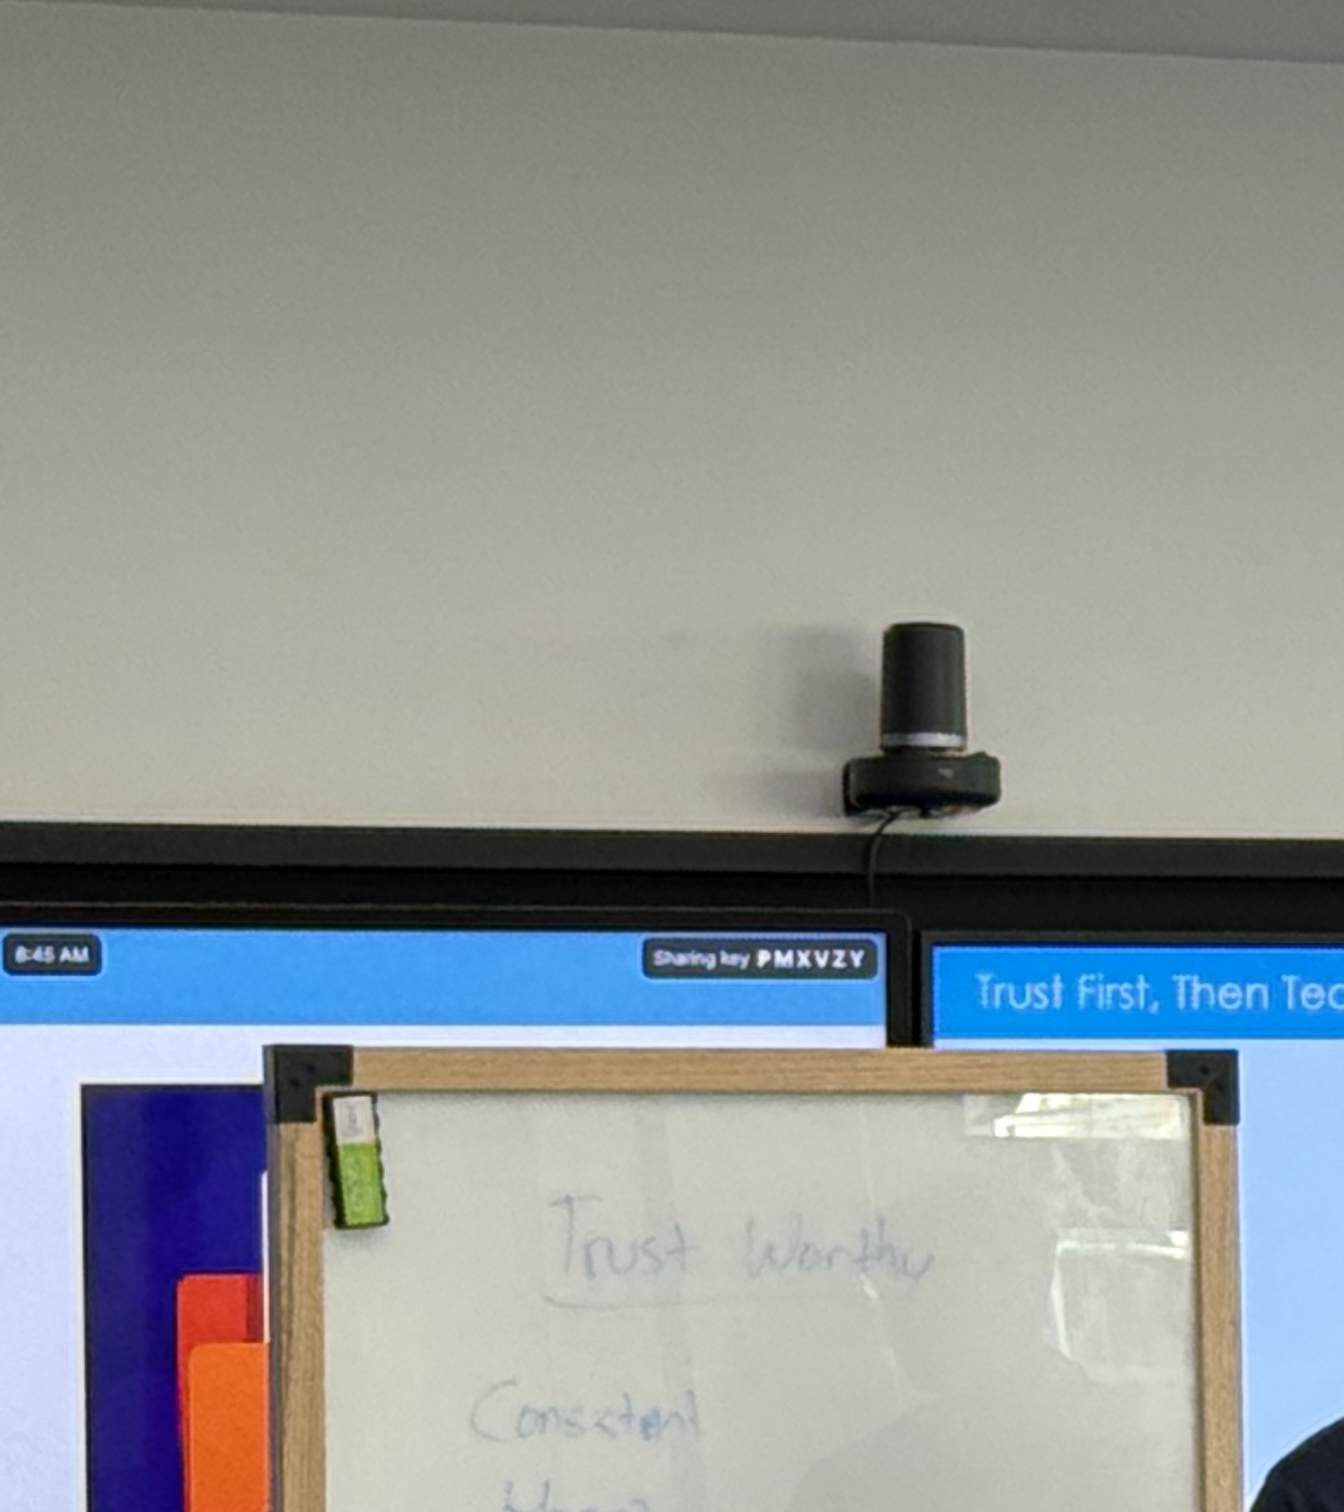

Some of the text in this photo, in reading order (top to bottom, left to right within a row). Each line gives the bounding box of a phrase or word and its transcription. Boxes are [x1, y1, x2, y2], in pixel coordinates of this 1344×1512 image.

[60, 945, 89, 963] AM
[653, 949, 865, 971] Sharing key PMXVZY
[975, 972, 1064, 1010] Trust
[1077, 972, 1160, 1014] First,
[1172, 972, 1270, 1010] Then
[546, 1193, 696, 1280] Trust
